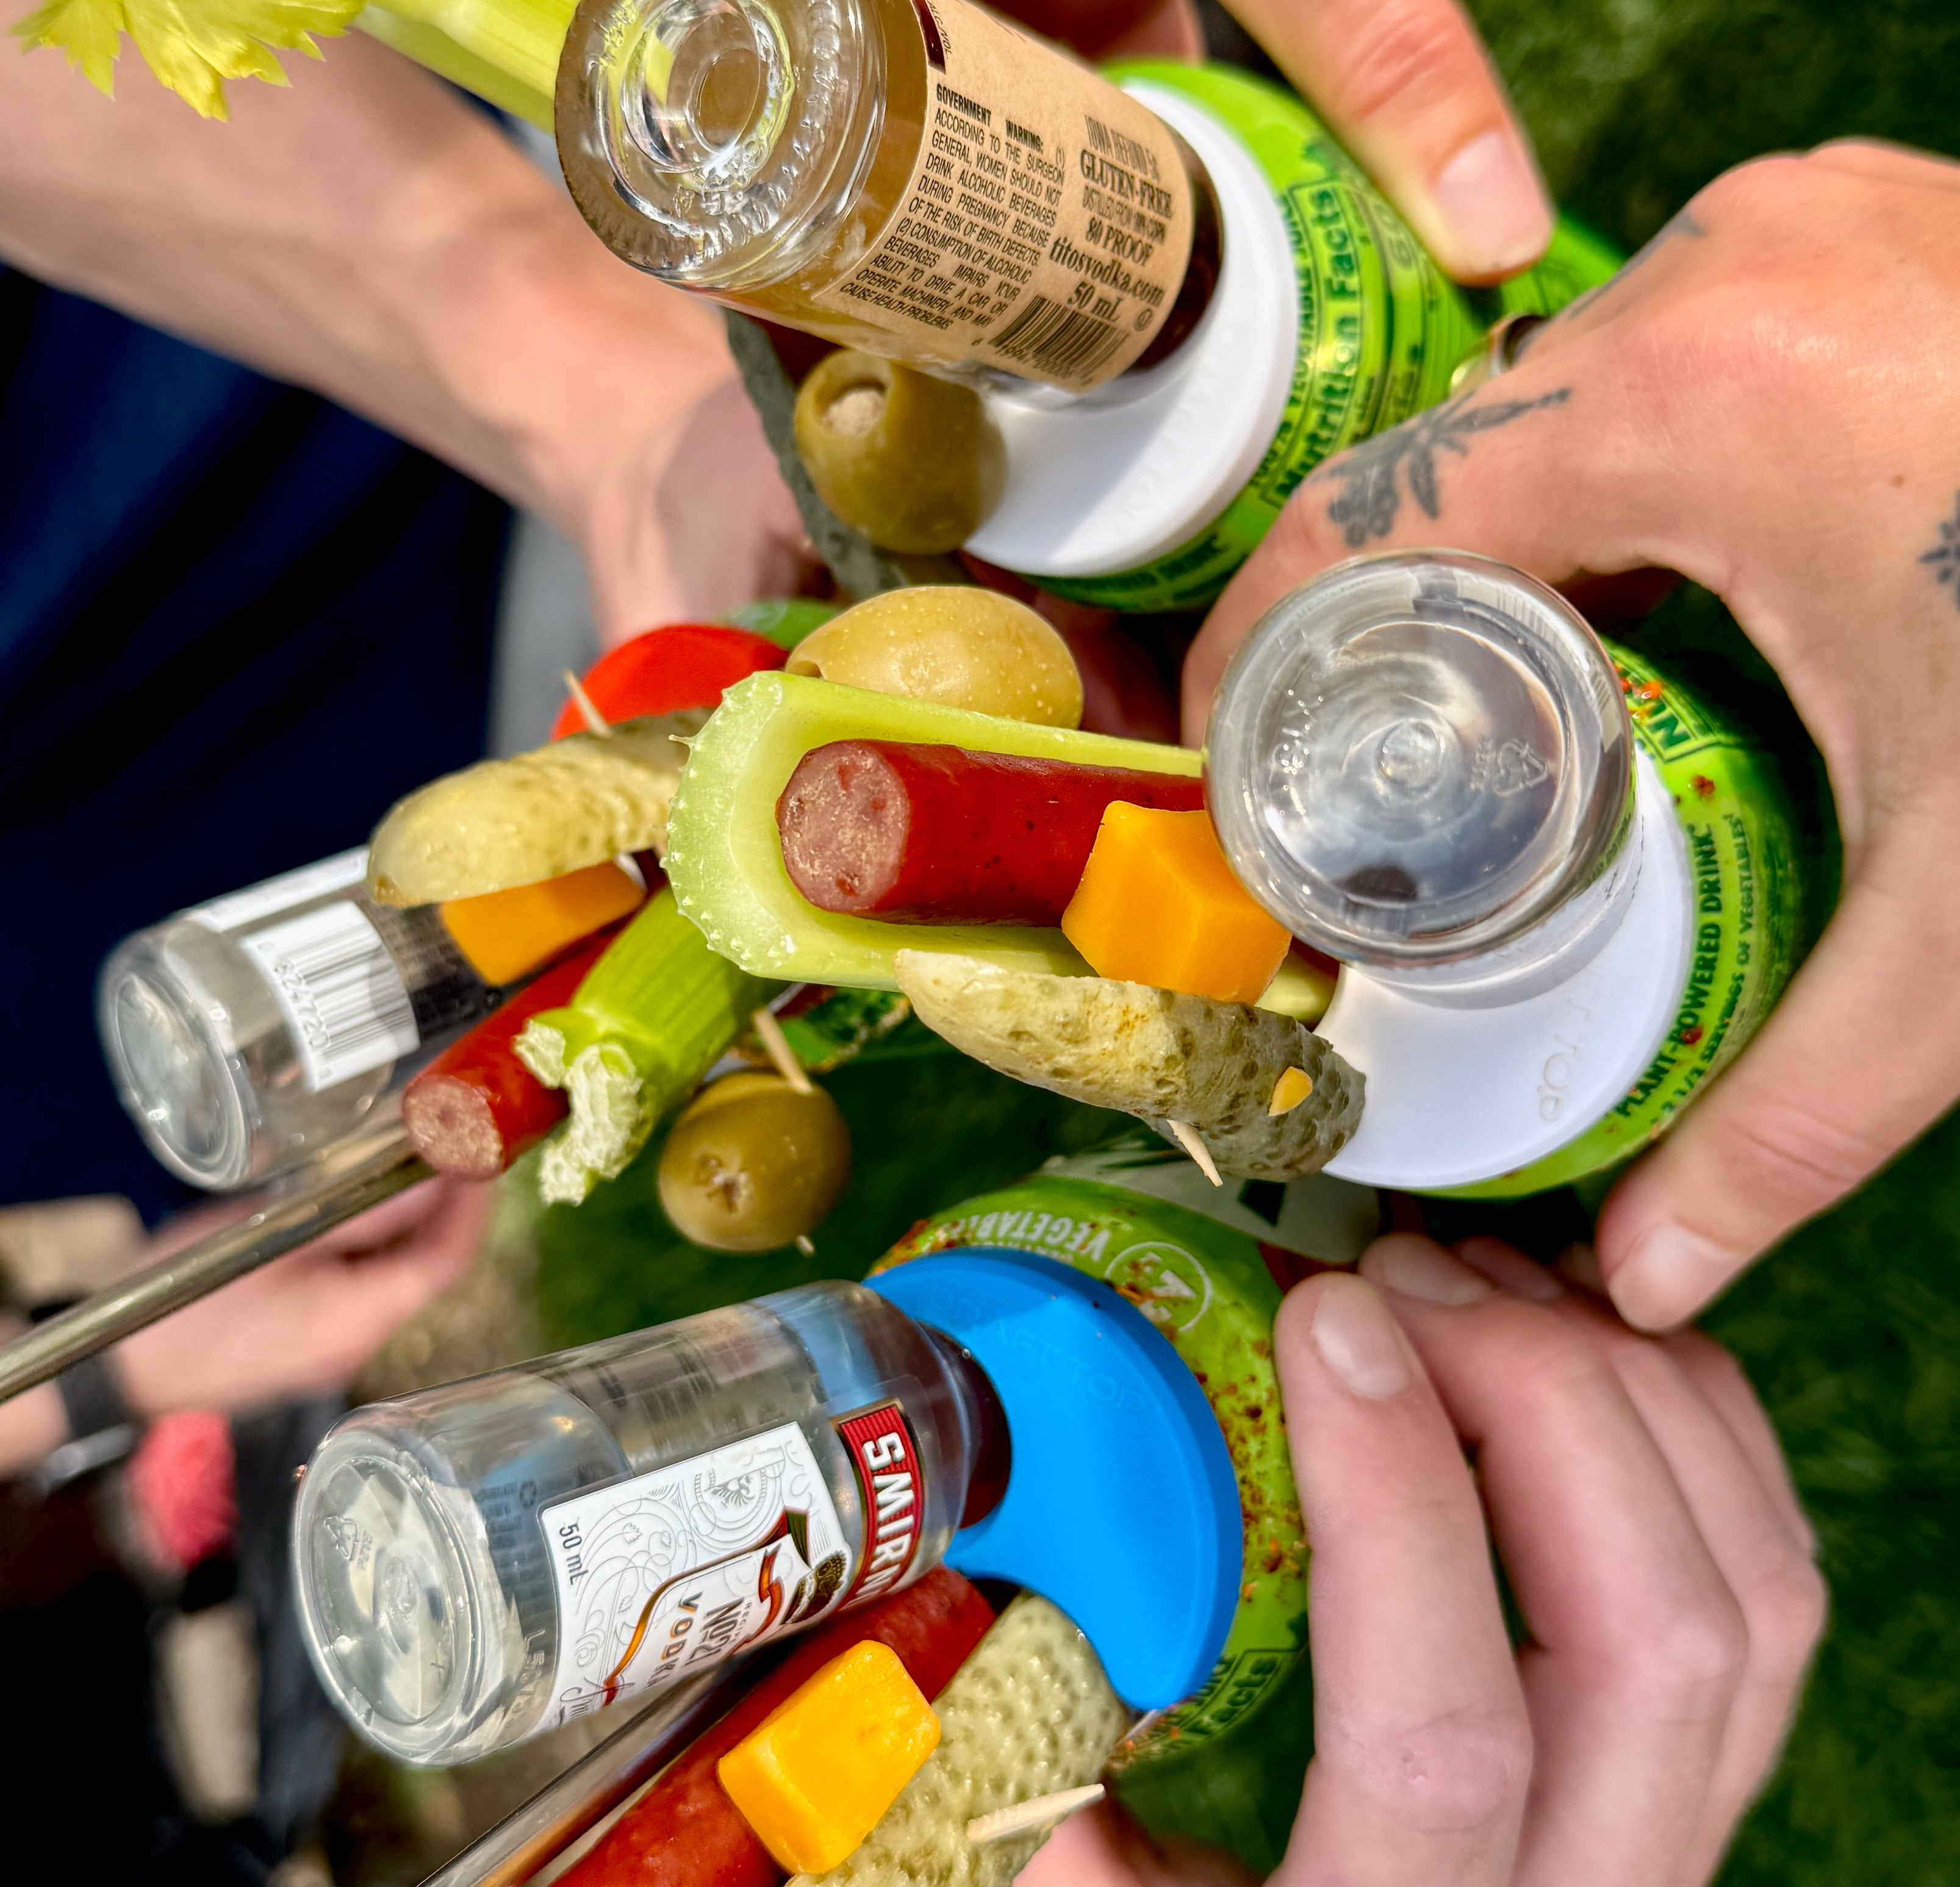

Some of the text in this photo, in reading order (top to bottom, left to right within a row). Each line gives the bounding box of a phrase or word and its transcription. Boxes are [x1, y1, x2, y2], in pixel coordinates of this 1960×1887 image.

[935, 108, 1064, 187] ACCORDING TO THE SURGEON
[936, 83, 991, 127] GOVERNMENT
[1005, 119, 1043, 154] WARNING:
[925, 152, 1057, 228] DRINK ALCOHOLIC BEVERAGES
[932, 130, 1062, 207] GENERAL, WOMEN SHOULD NOT
[909, 196, 925, 213] OF
[922, 202, 944, 224] THE
[941, 211, 965, 234] RISK
[963, 221, 979, 238] OF
[976, 226, 1004, 251] BIRTH
[917, 174, 1051, 248] DURING PREGNANCY BECAUSE
[1085, 217, 1154, 267] 80 PROOF
[1312, 190, 1359, 301] Facts
[869, 253, 1008, 317] ABILITY TO DRIVE A CAR OR
[884, 235, 1021, 301] BEVERAGES IMPAIRS YOUR
[895, 217, 1032, 285] (2) CONSUMPTION OF ALCOHOLIC
[1049, 235, 1165, 306] titosvodka.com
[839, 282, 877, 301] CAUSE
[869, 295, 908, 317] HEALTH
[856, 269, 902, 293] OPERATE
[950, 306, 975, 321] AND
[971, 313, 995, 328] MAY
[1067, 281, 1096, 309] 50
[1091, 296, 1124, 323] mL
[1614, 922, 1722, 1117] PLANT-POWERED
[1700, 972, 1745, 1061] SERVINGS
[1736, 940, 1751, 966] OF
[558, 1522, 590, 1586] 50 mL
